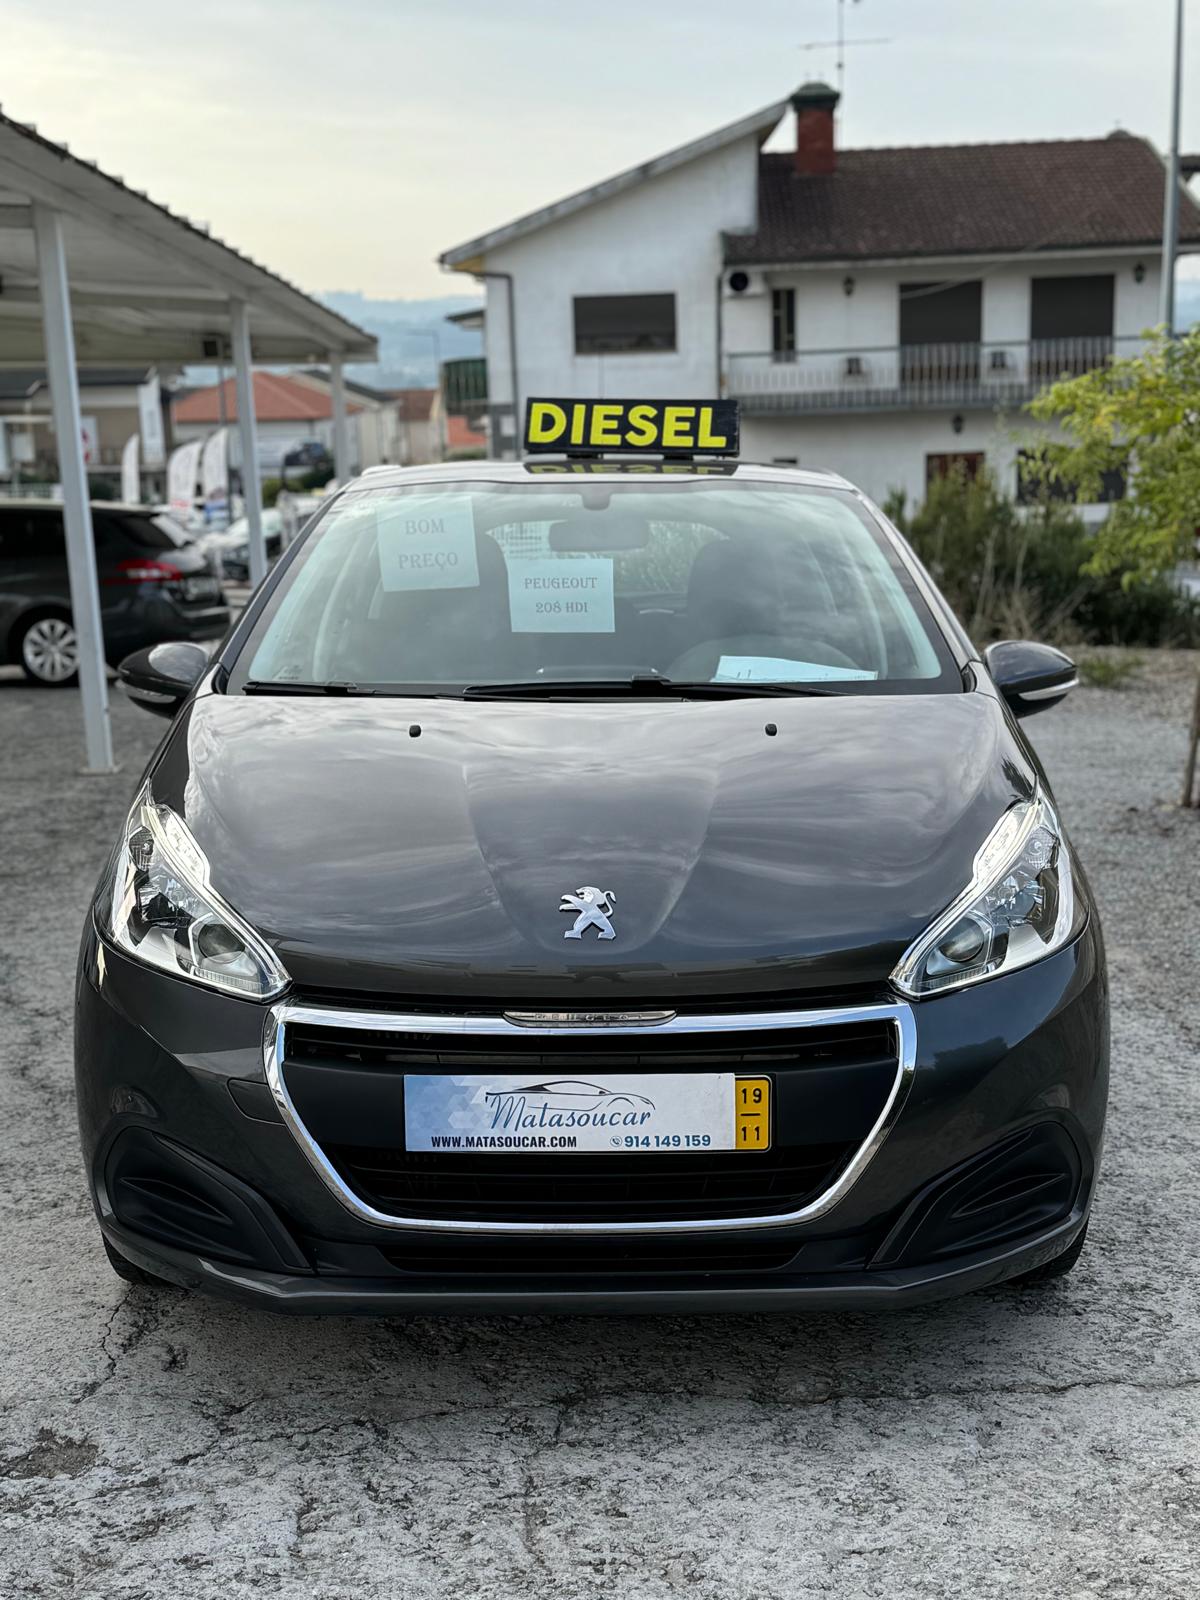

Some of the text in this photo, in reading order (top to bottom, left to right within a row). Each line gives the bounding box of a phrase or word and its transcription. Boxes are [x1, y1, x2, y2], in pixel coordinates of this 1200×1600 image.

[528, 402, 727, 448] DIESEL
[405, 518, 445, 535] BOM
[398, 552, 458, 571] PREÇO
[524, 577, 598, 589] PEUGEOUT
[535, 602, 589, 614] 208 HDI
[741, 1087, 763, 1104] 19
[488, 1095, 651, 1132] Matasoucar
[624, 1134, 711, 1148] 914 149 159
[741, 1126, 760, 1141] 11
[431, 1136, 577, 1148] WWW.MATASOUCAR.COM
